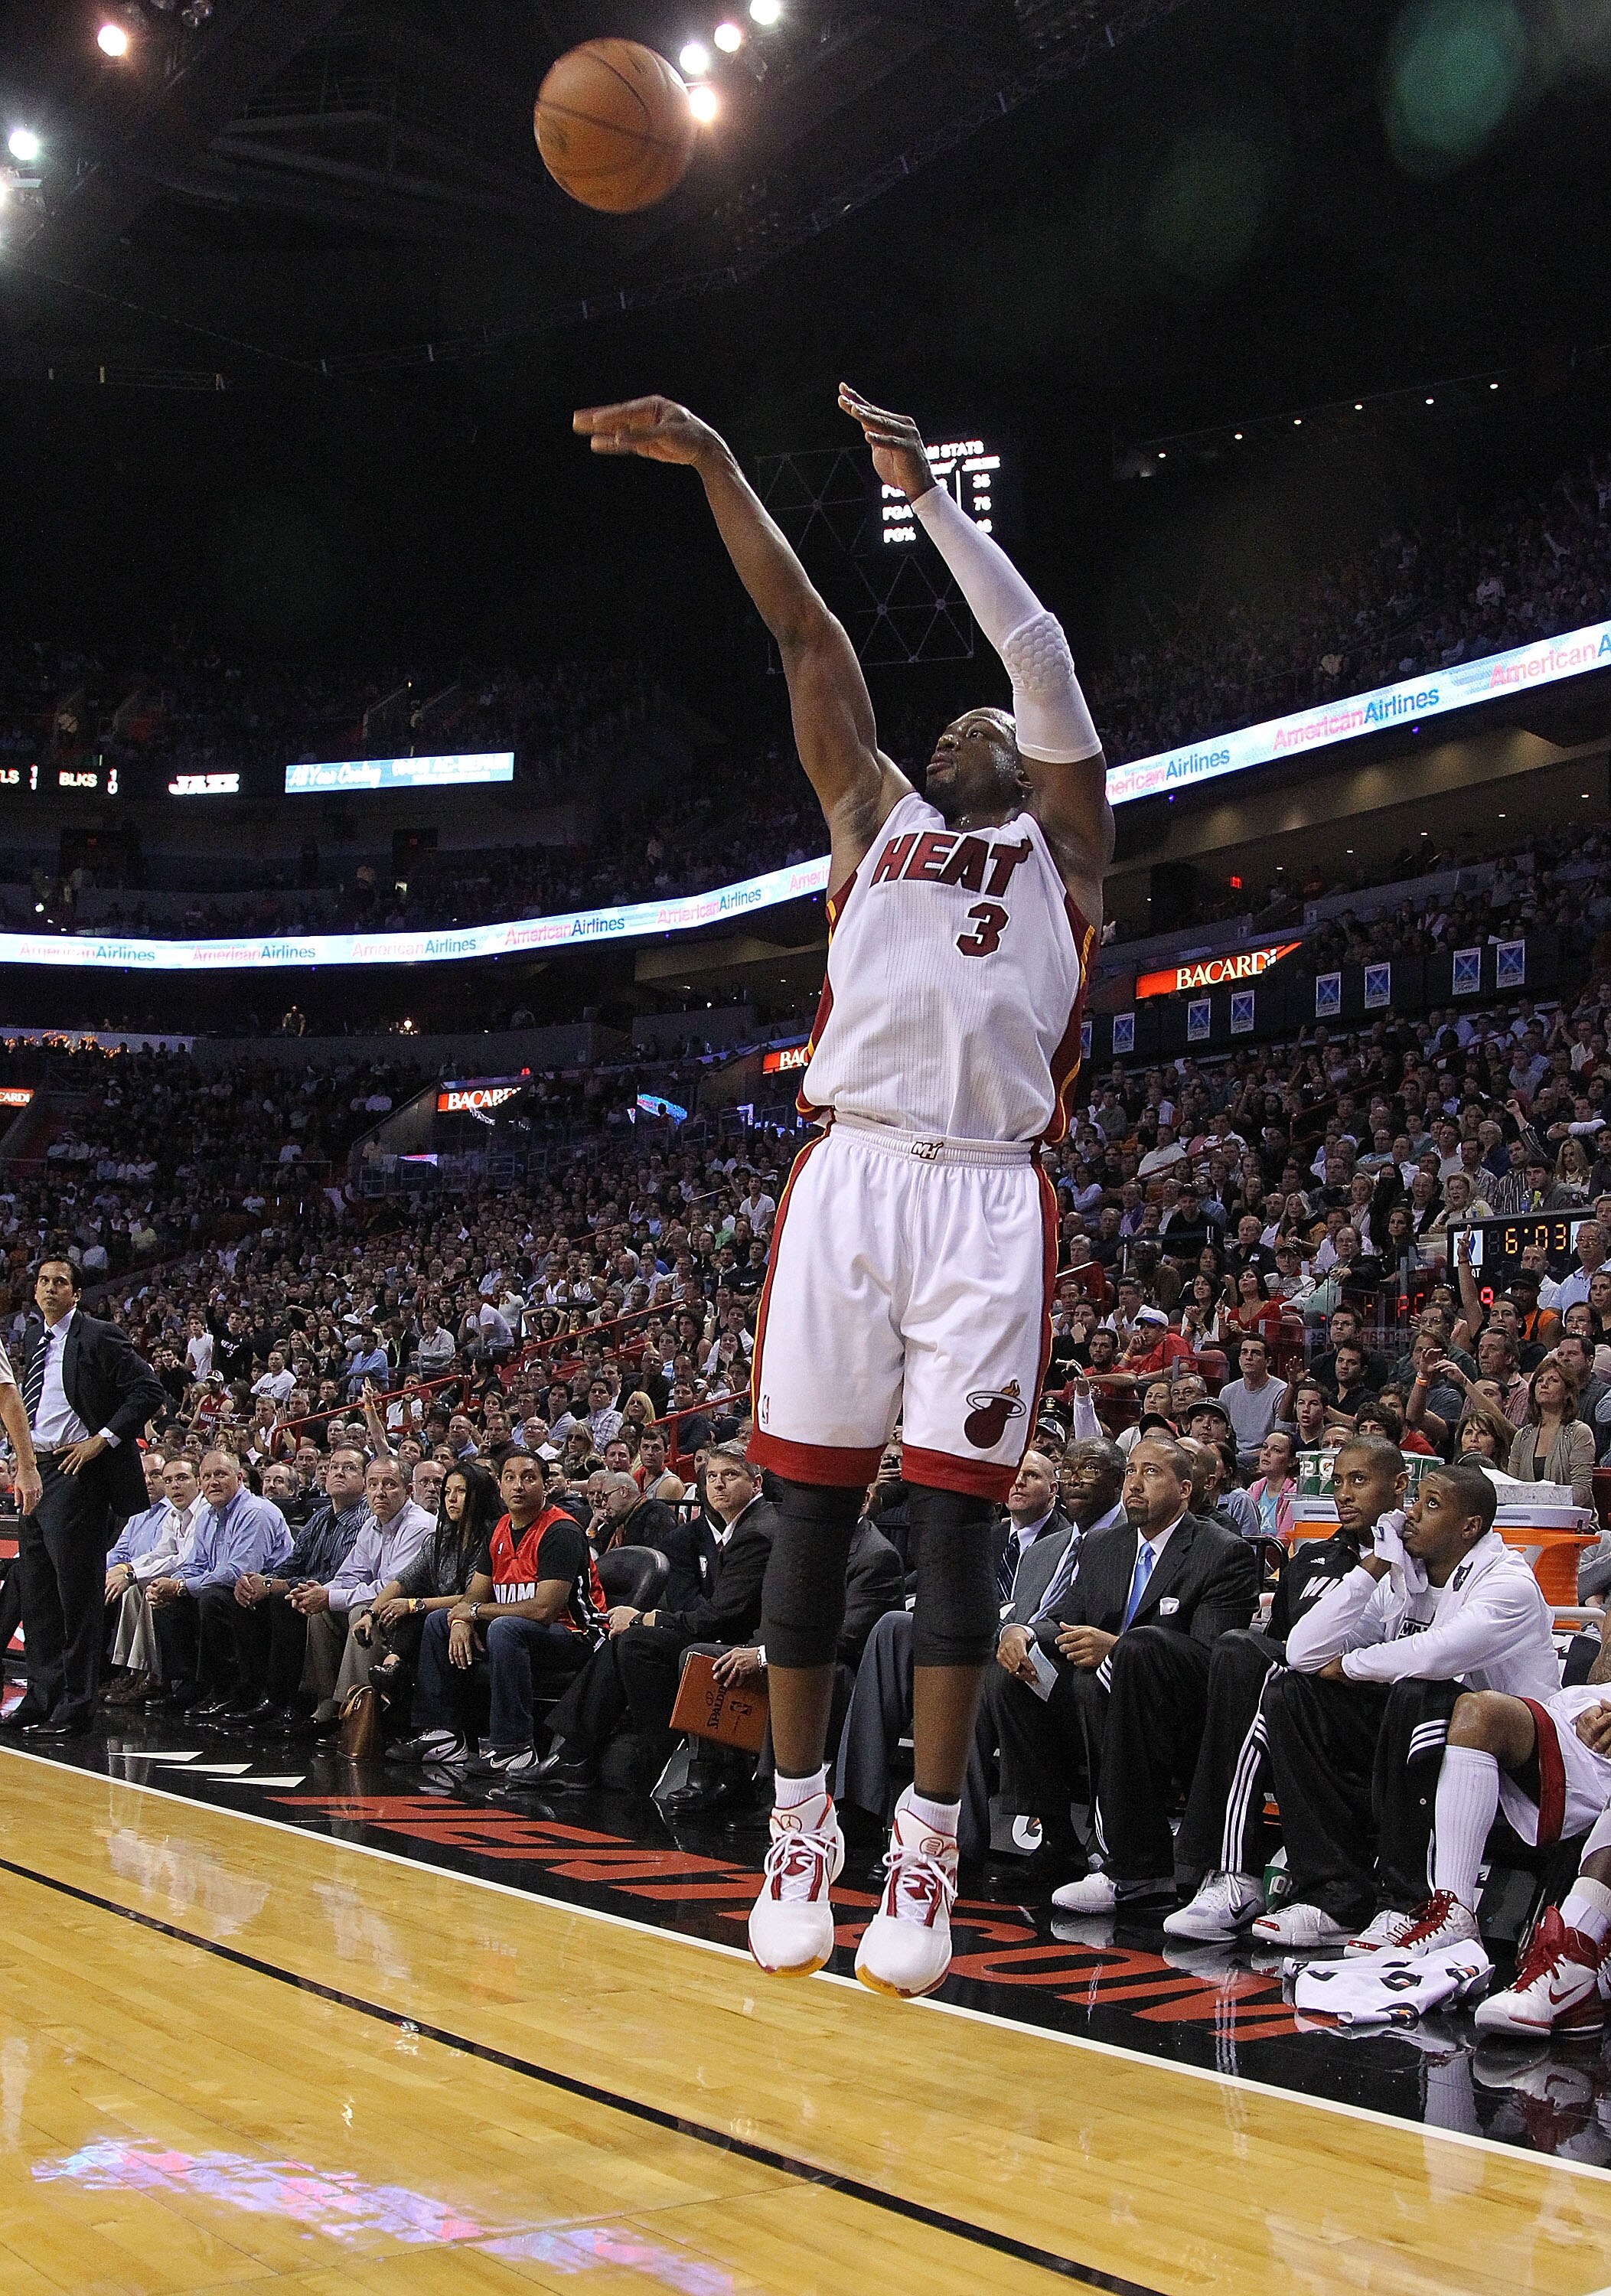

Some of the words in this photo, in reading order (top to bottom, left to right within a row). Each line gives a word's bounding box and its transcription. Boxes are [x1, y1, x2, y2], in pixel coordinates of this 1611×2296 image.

[941, 440, 984, 458] STATS
[59, 770, 98, 788] BLKS
[168, 772, 240, 795] JAZZ
[869, 831, 1034, 897] HEAT
[956, 902, 1010, 957] 3
